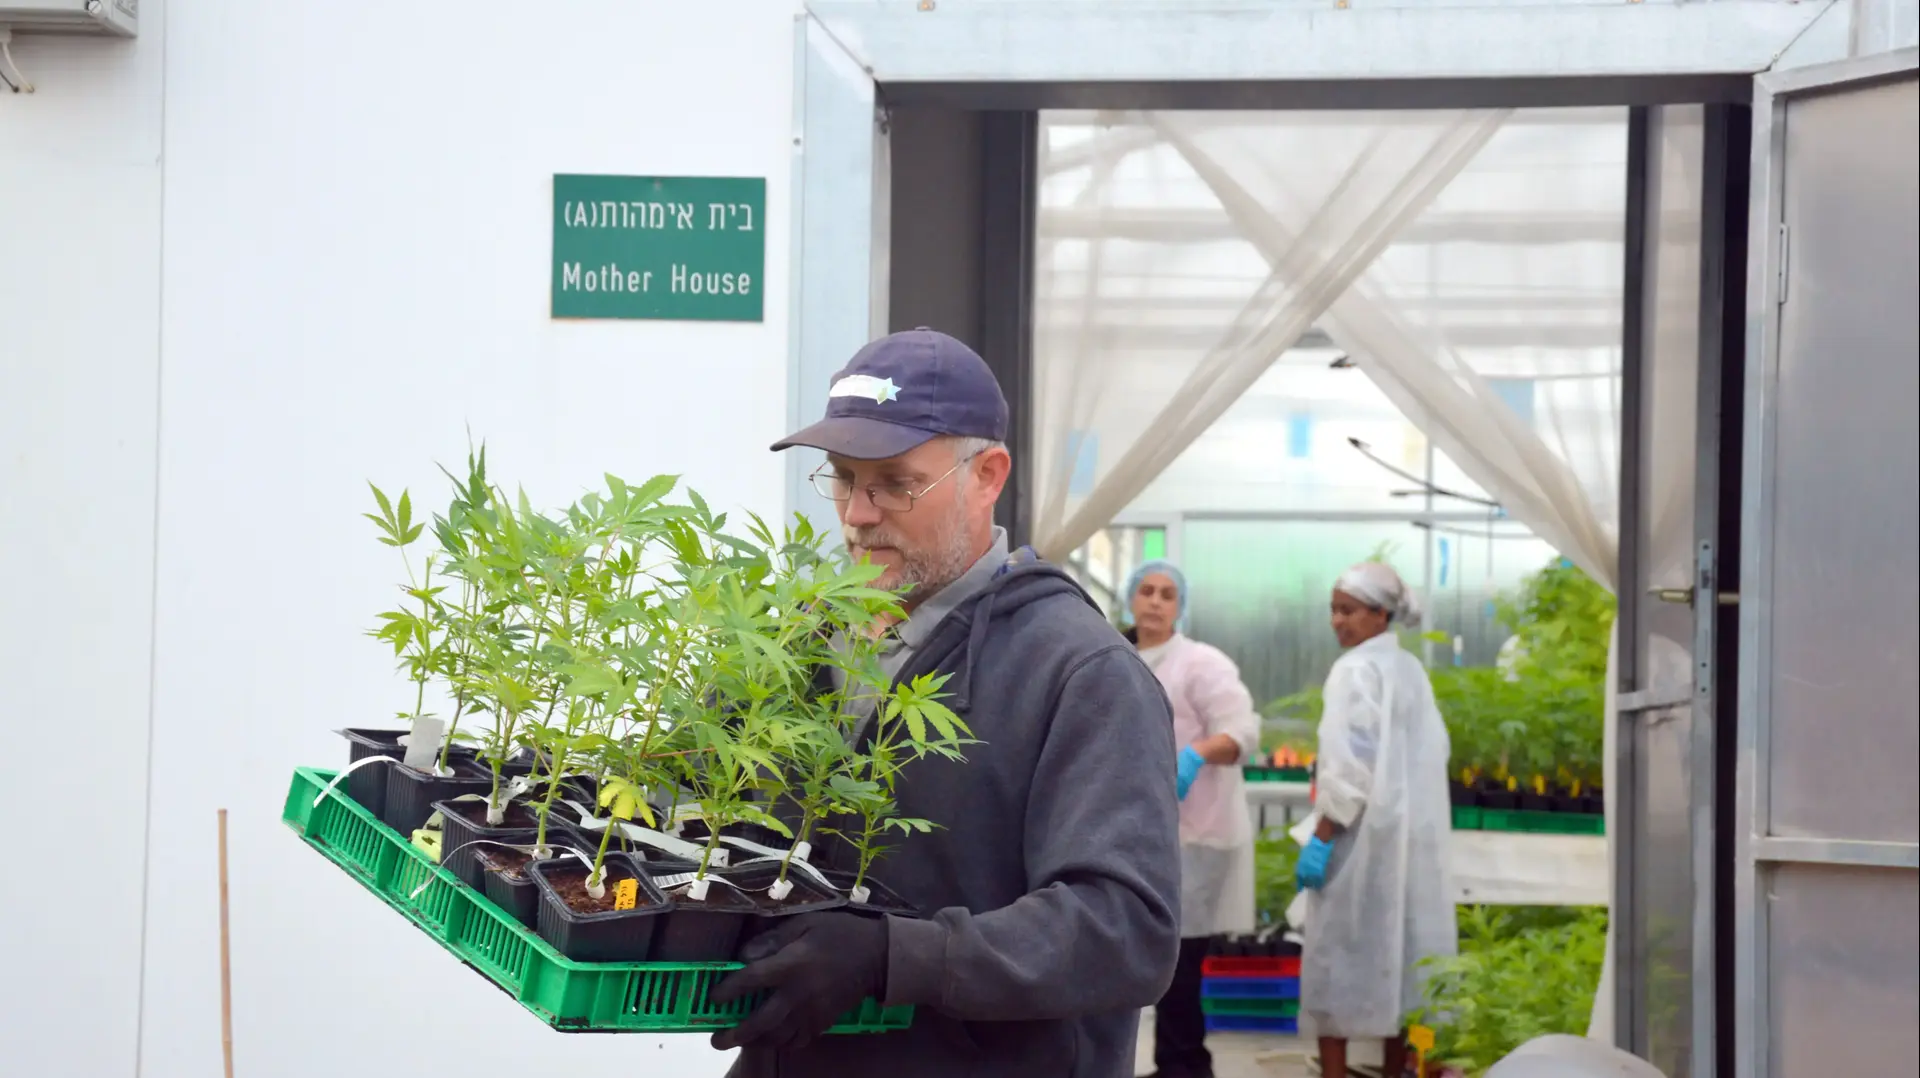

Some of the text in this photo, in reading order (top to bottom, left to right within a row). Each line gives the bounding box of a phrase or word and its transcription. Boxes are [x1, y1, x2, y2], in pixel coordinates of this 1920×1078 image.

[708, 203, 753, 231] בית
[562, 261, 751, 295] Mother House
